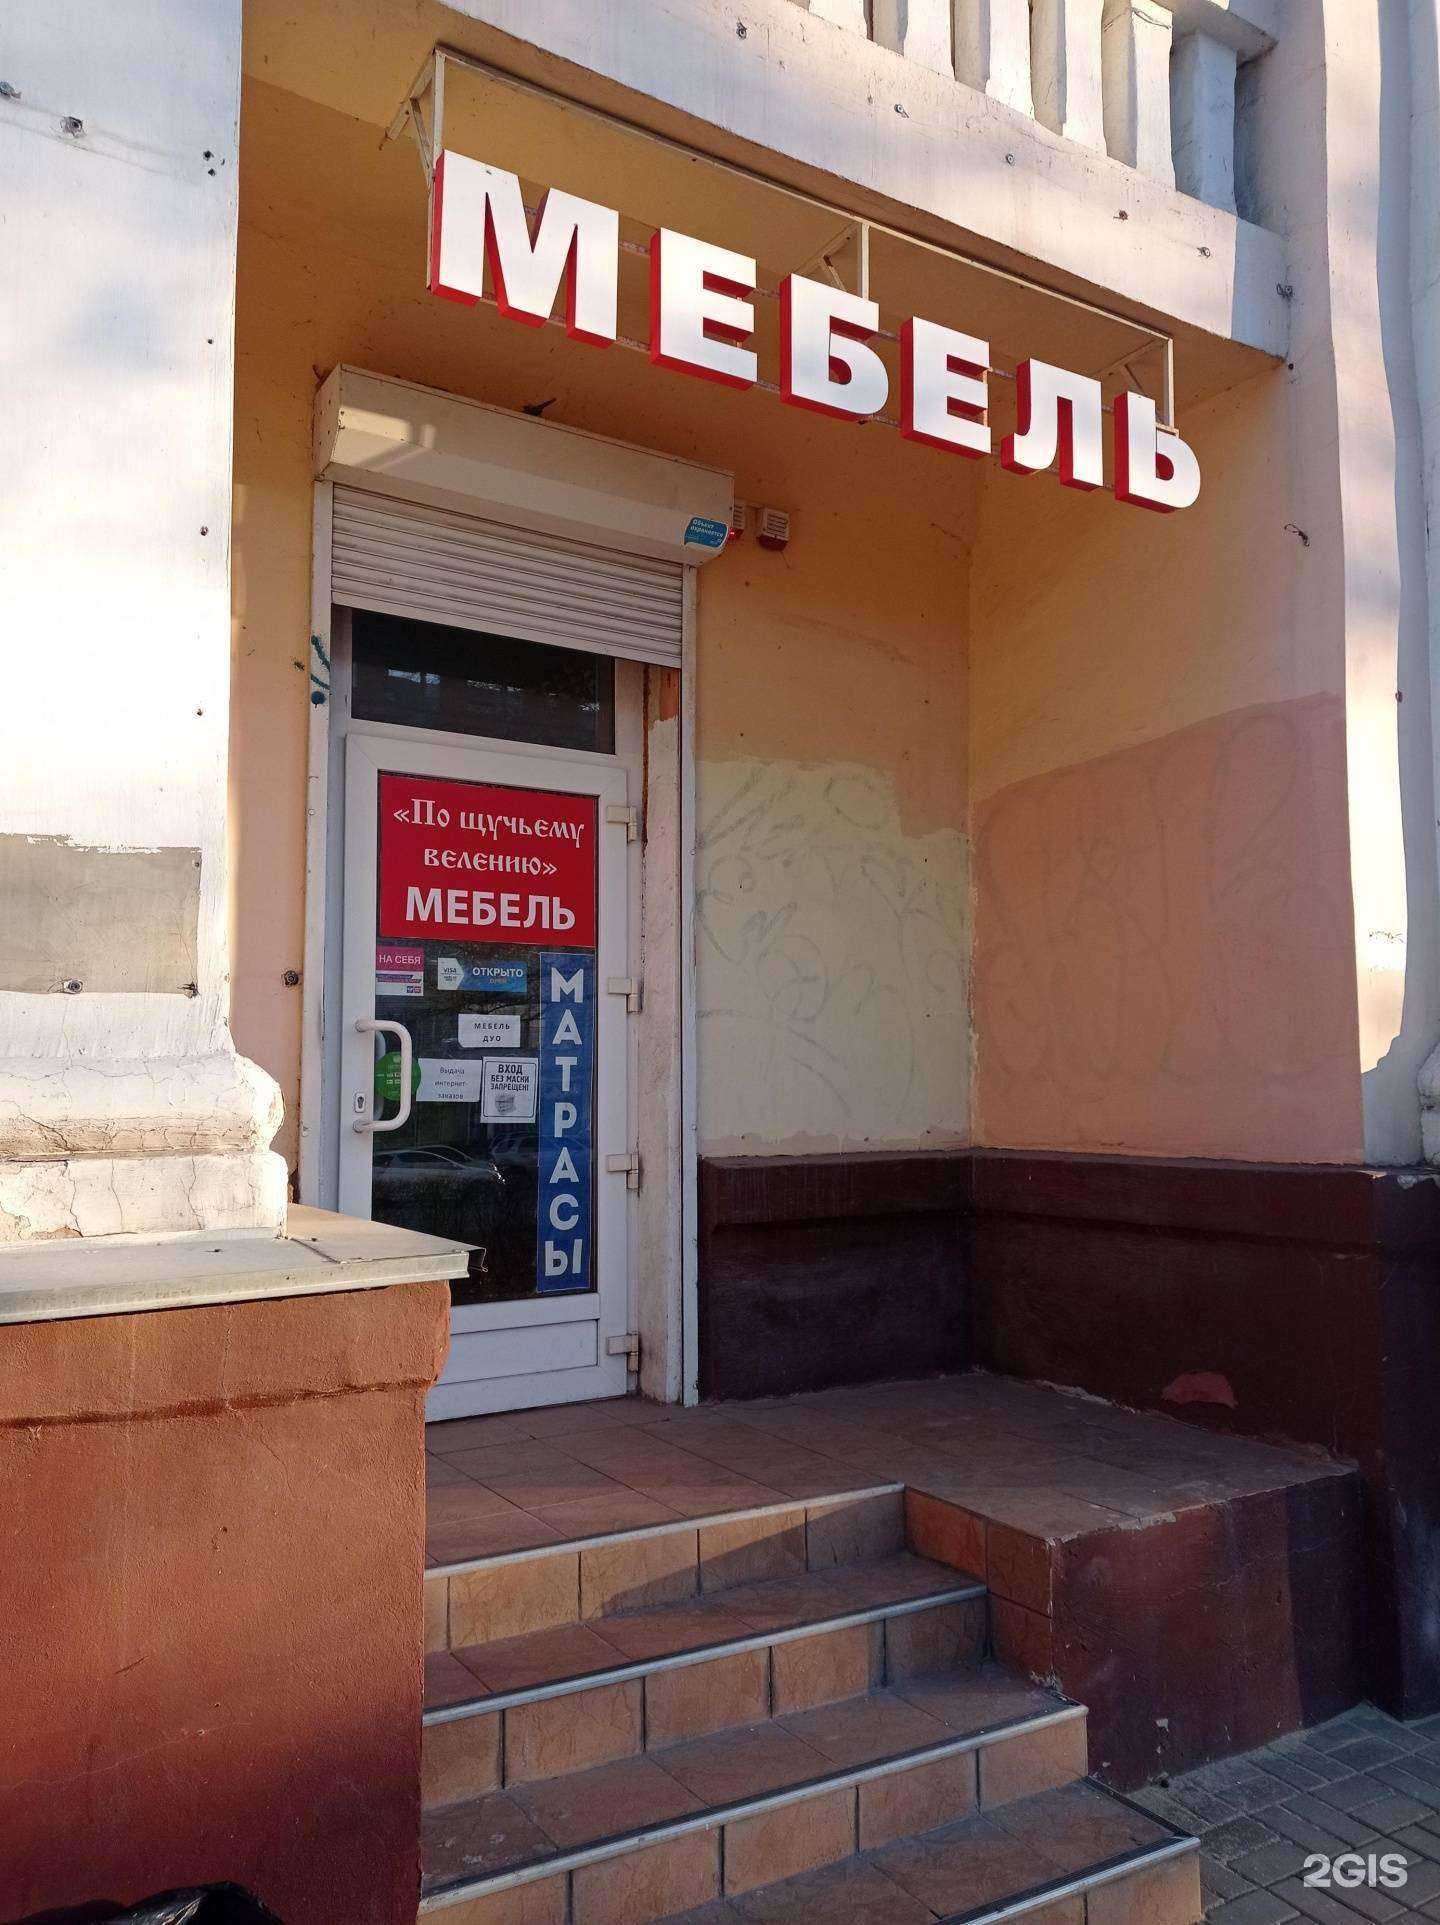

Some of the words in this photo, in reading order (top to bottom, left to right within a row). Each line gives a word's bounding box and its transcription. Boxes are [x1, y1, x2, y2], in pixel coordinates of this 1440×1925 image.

[432, 149, 1201, 513] МЕБЕЛЬ
[393, 798, 450, 828] «По
[460, 811, 585, 849] щучьему
[424, 848, 557, 876] велению»
[405, 886, 576, 931] МЕБЕЛЬ
[379, 954, 392, 964] НА
[395, 954, 421, 965] СЕБЯ
[472, 966, 524, 978] ОТКРЫТО
[474, 1022, 511, 1030] МЕБЕЛЬ
[482, 1035, 501, 1043] ДУО
[440, 1067, 465, 1075] Выдача
[498, 1064, 523, 1075] ВХОД
[490, 1075, 504, 1083] БЕЗ
[506, 1076, 530, 1084] МАСКИ
[438, 1092, 464, 1100] заказов
[544, 966, 584, 1277] МАТРАСЫ
